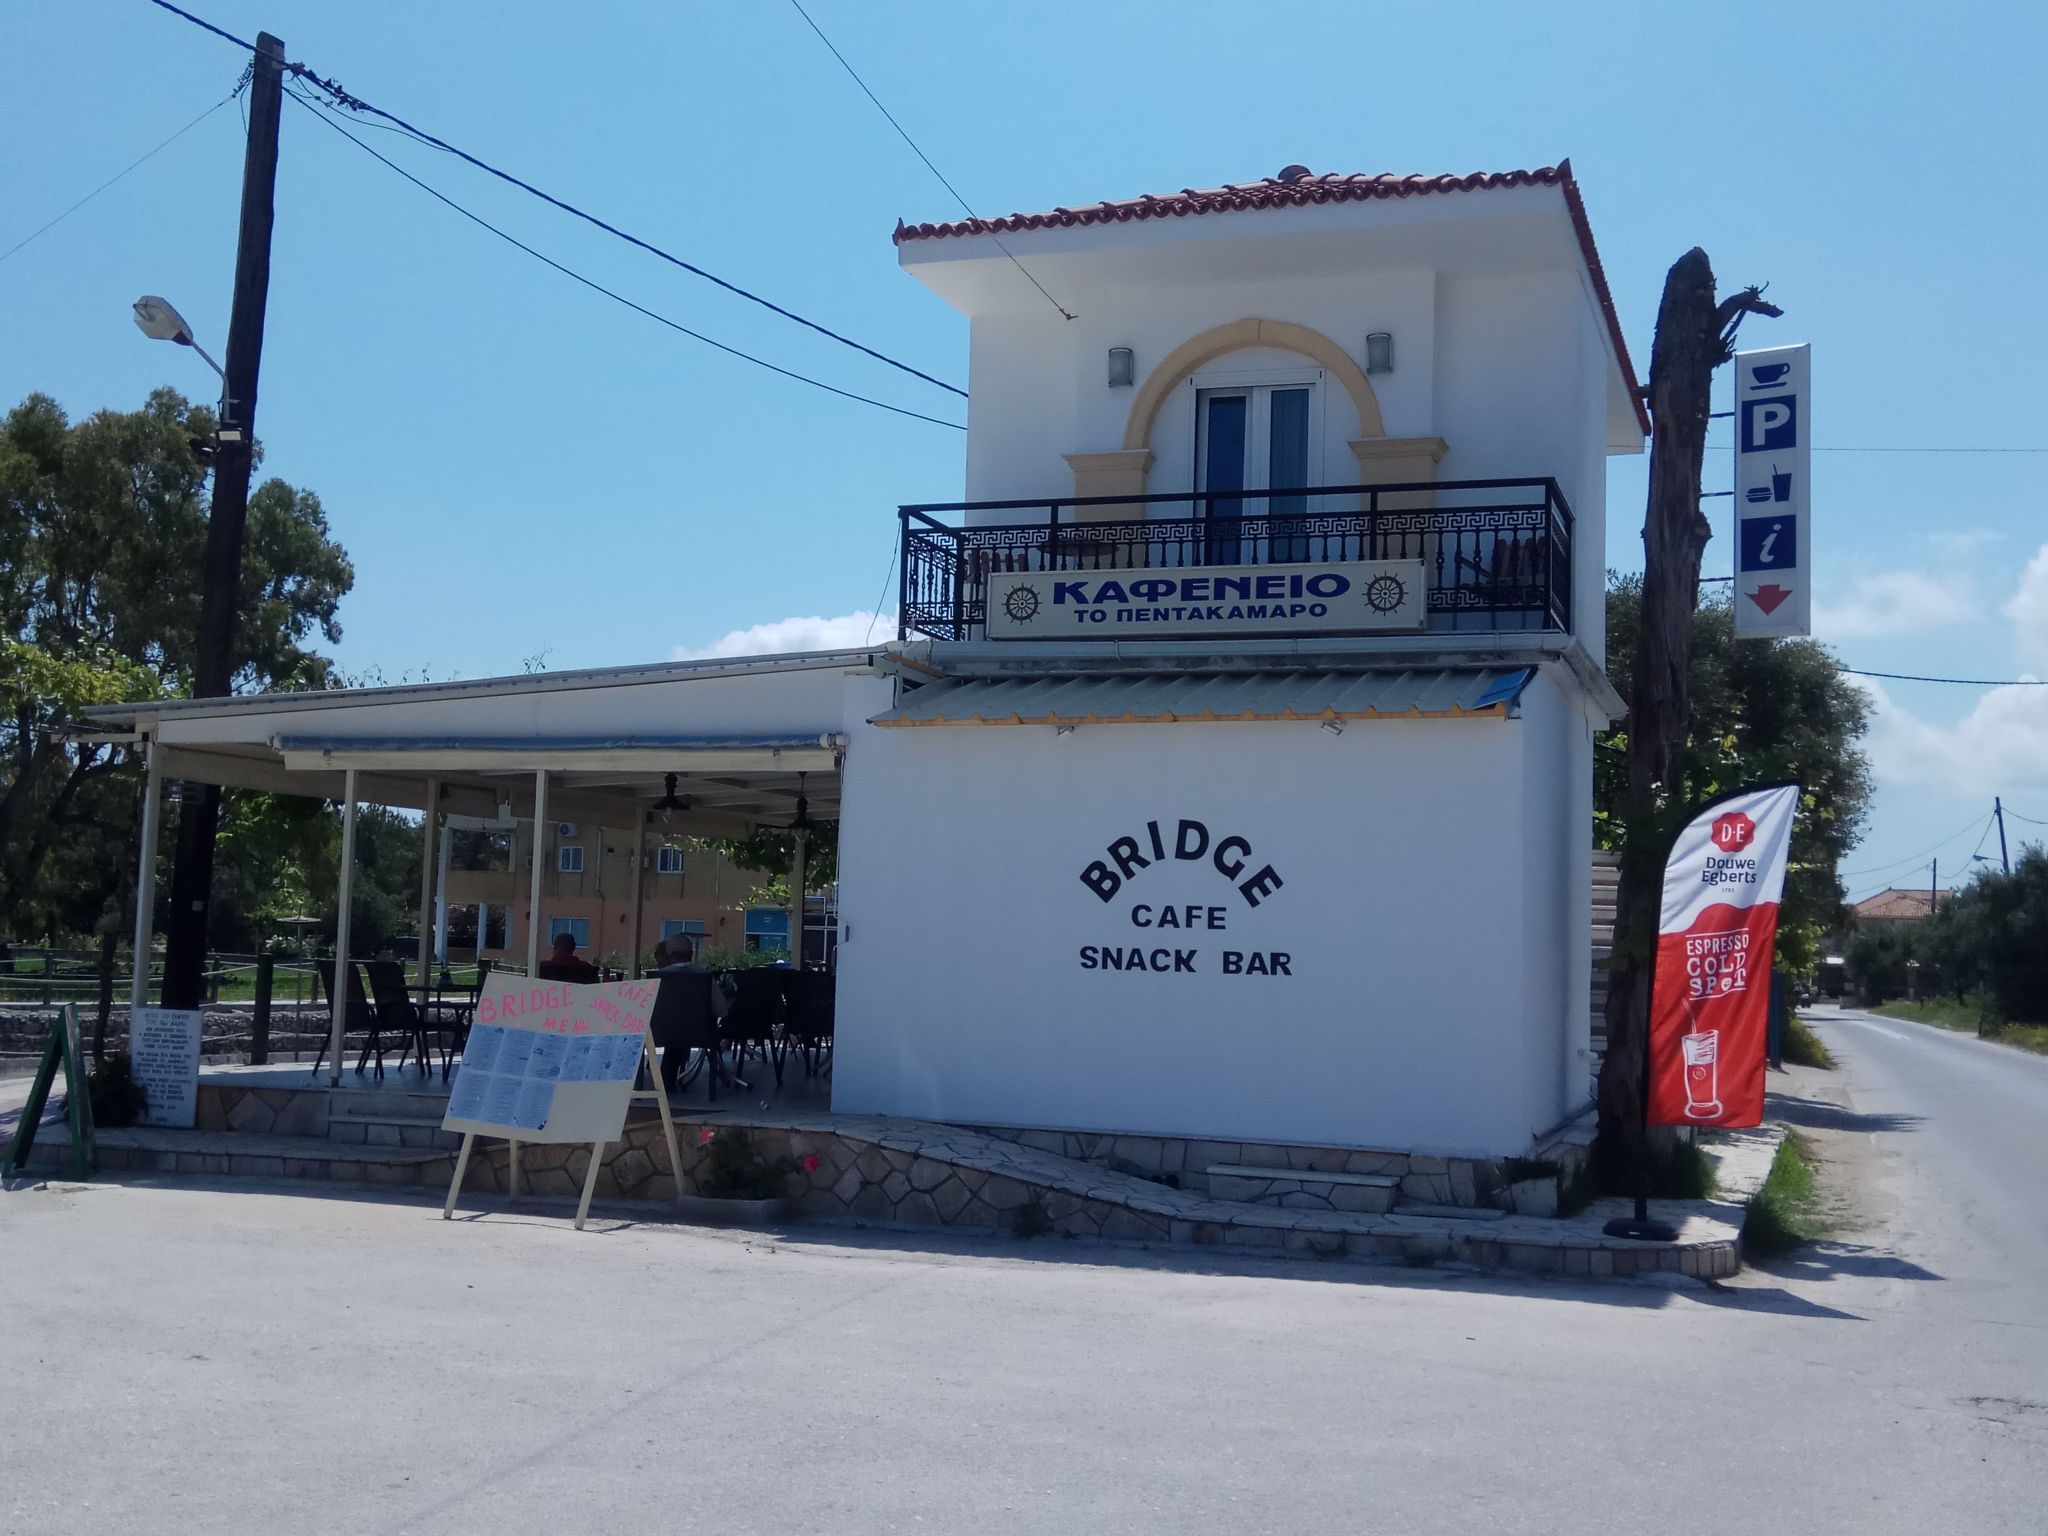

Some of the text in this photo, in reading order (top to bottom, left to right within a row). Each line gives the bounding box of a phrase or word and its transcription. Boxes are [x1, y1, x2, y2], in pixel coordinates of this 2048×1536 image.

[1752, 402, 1791, 447] P
[1053, 573, 1351, 605] ΚΑΦΕΝΕΙΟ
[1074, 603, 1328, 623] ΤΟ ΠΕΝΤΑΚΑΜΑΡΟ
[1079, 819, 1284, 908] BRIDGE
[1706, 856, 1756, 869] Douwe
[1702, 870, 1757, 886] Egberts
[1131, 904, 1227, 930] CAFE
[1686, 934, 1749, 956] ESPRESSO
[1079, 945, 1292, 976] SNACK BAR
[1687, 952, 1746, 976] COLD
[618, 982, 653, 1008] CAFE
[1689, 968, 1746, 996] SPOT
[480, 984, 574, 1024] BRIDGE
[543, 1017, 590, 1033] MENU
